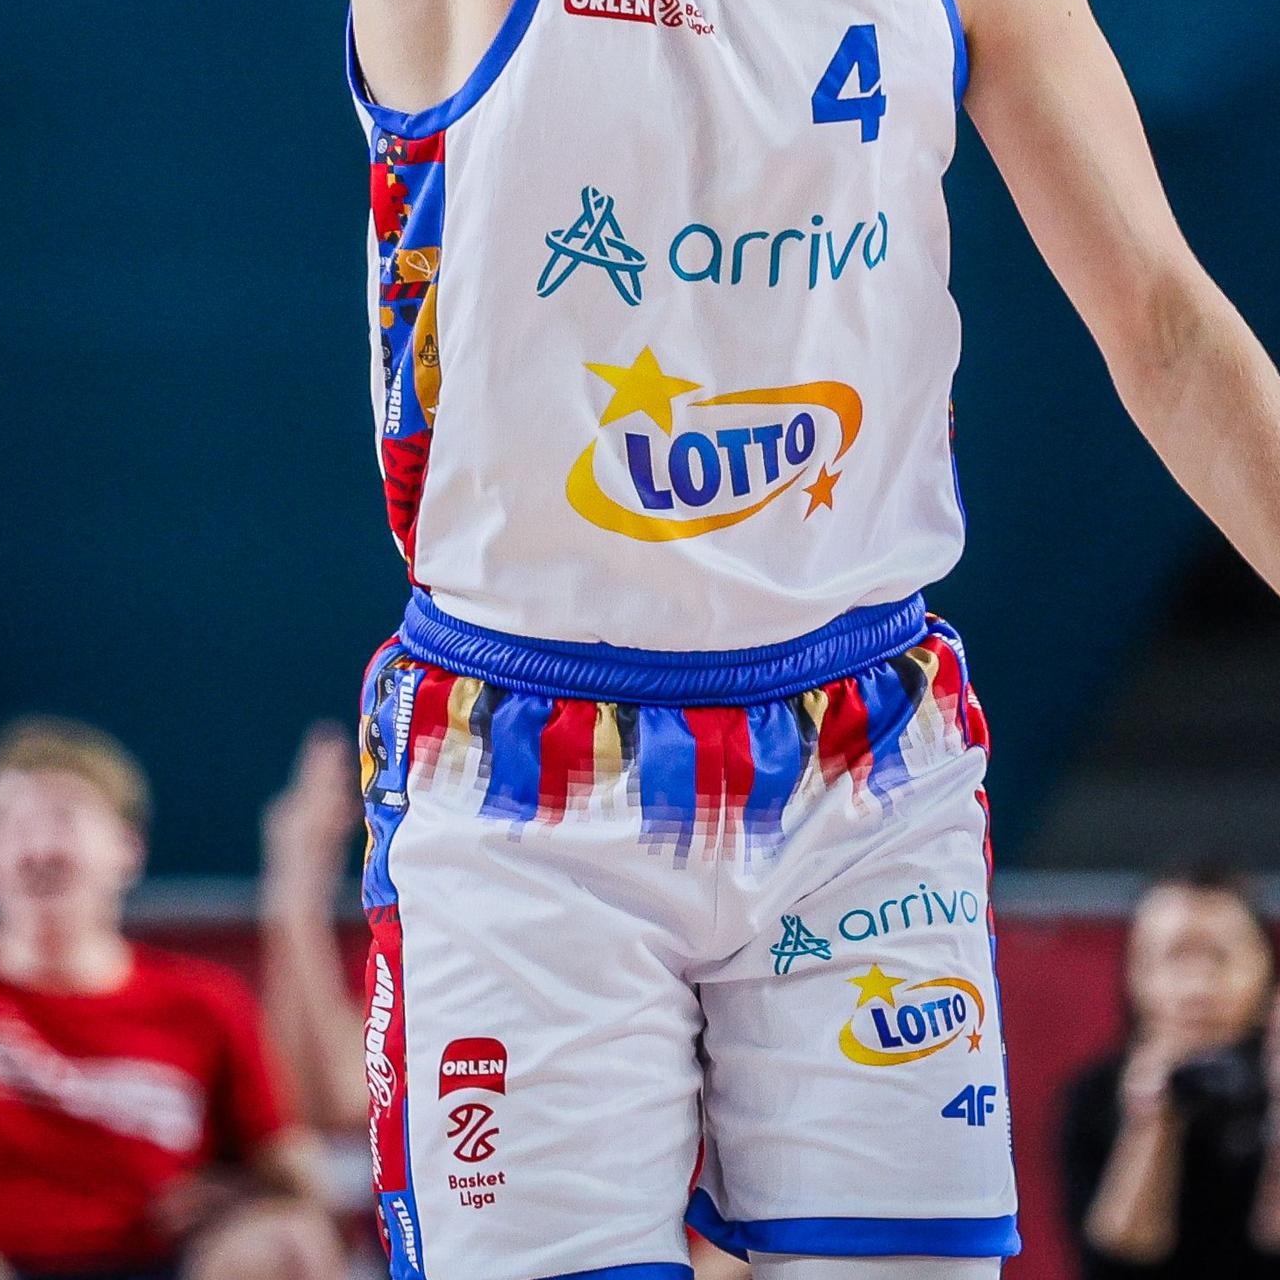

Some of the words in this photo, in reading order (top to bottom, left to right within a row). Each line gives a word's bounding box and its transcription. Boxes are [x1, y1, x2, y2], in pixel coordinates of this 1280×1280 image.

[811, 24, 887, 143] 4
[668, 211, 888, 289] arriva
[624, 412, 816, 510] LOTTO
[871, 993, 967, 1048] LOTTO
[441, 1057, 505, 1078] ORLEN
[941, 1084, 997, 1126] 4F
[448, 1171, 506, 1189] Basket
[459, 1190, 496, 1208] Liga
